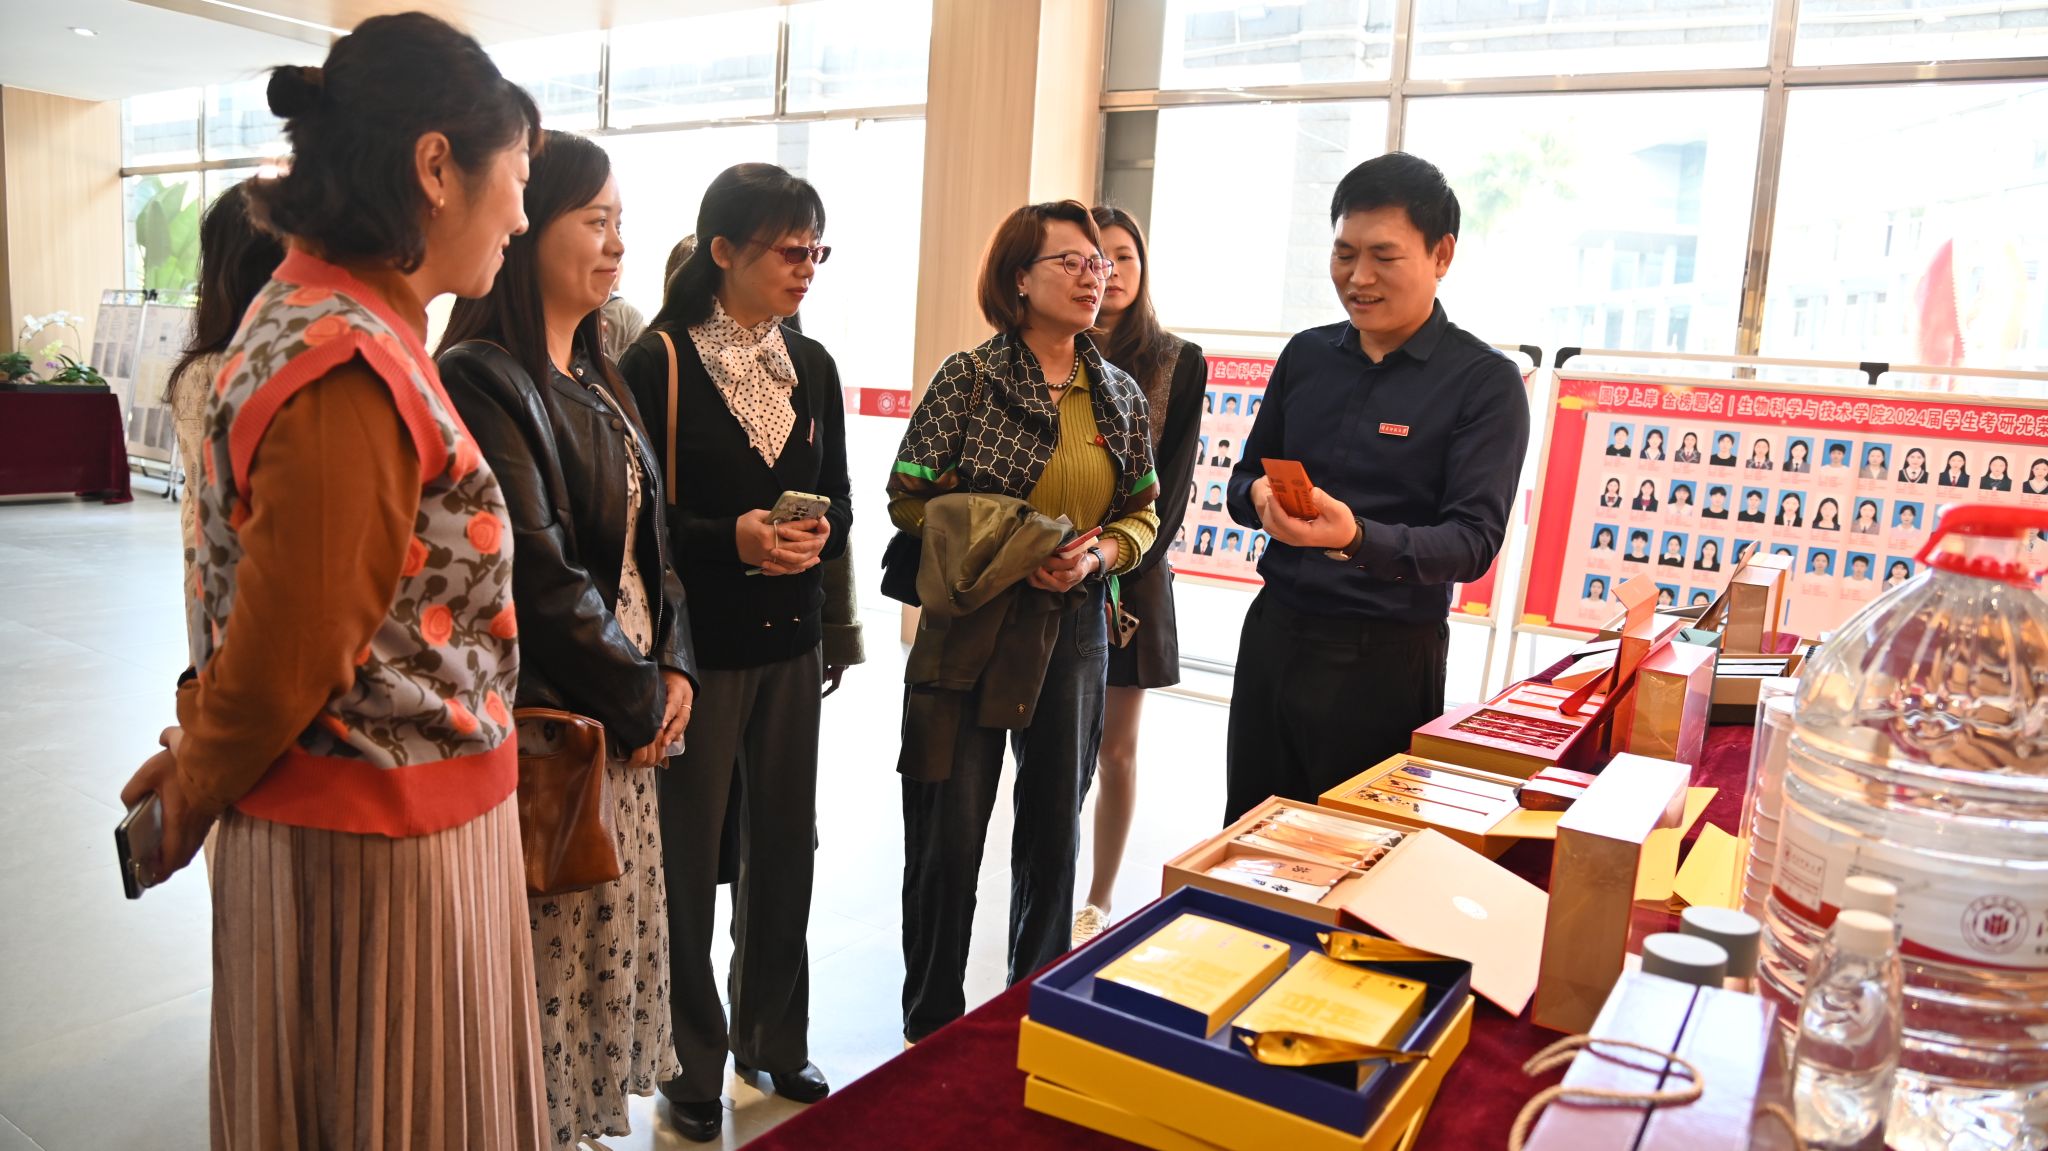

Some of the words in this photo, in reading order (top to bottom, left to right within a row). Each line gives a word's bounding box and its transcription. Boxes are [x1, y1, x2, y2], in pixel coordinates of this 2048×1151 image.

[1599, 385, 1659, 409] 圆梦上岸
[1662, 391, 1724, 414] 金榜题名
